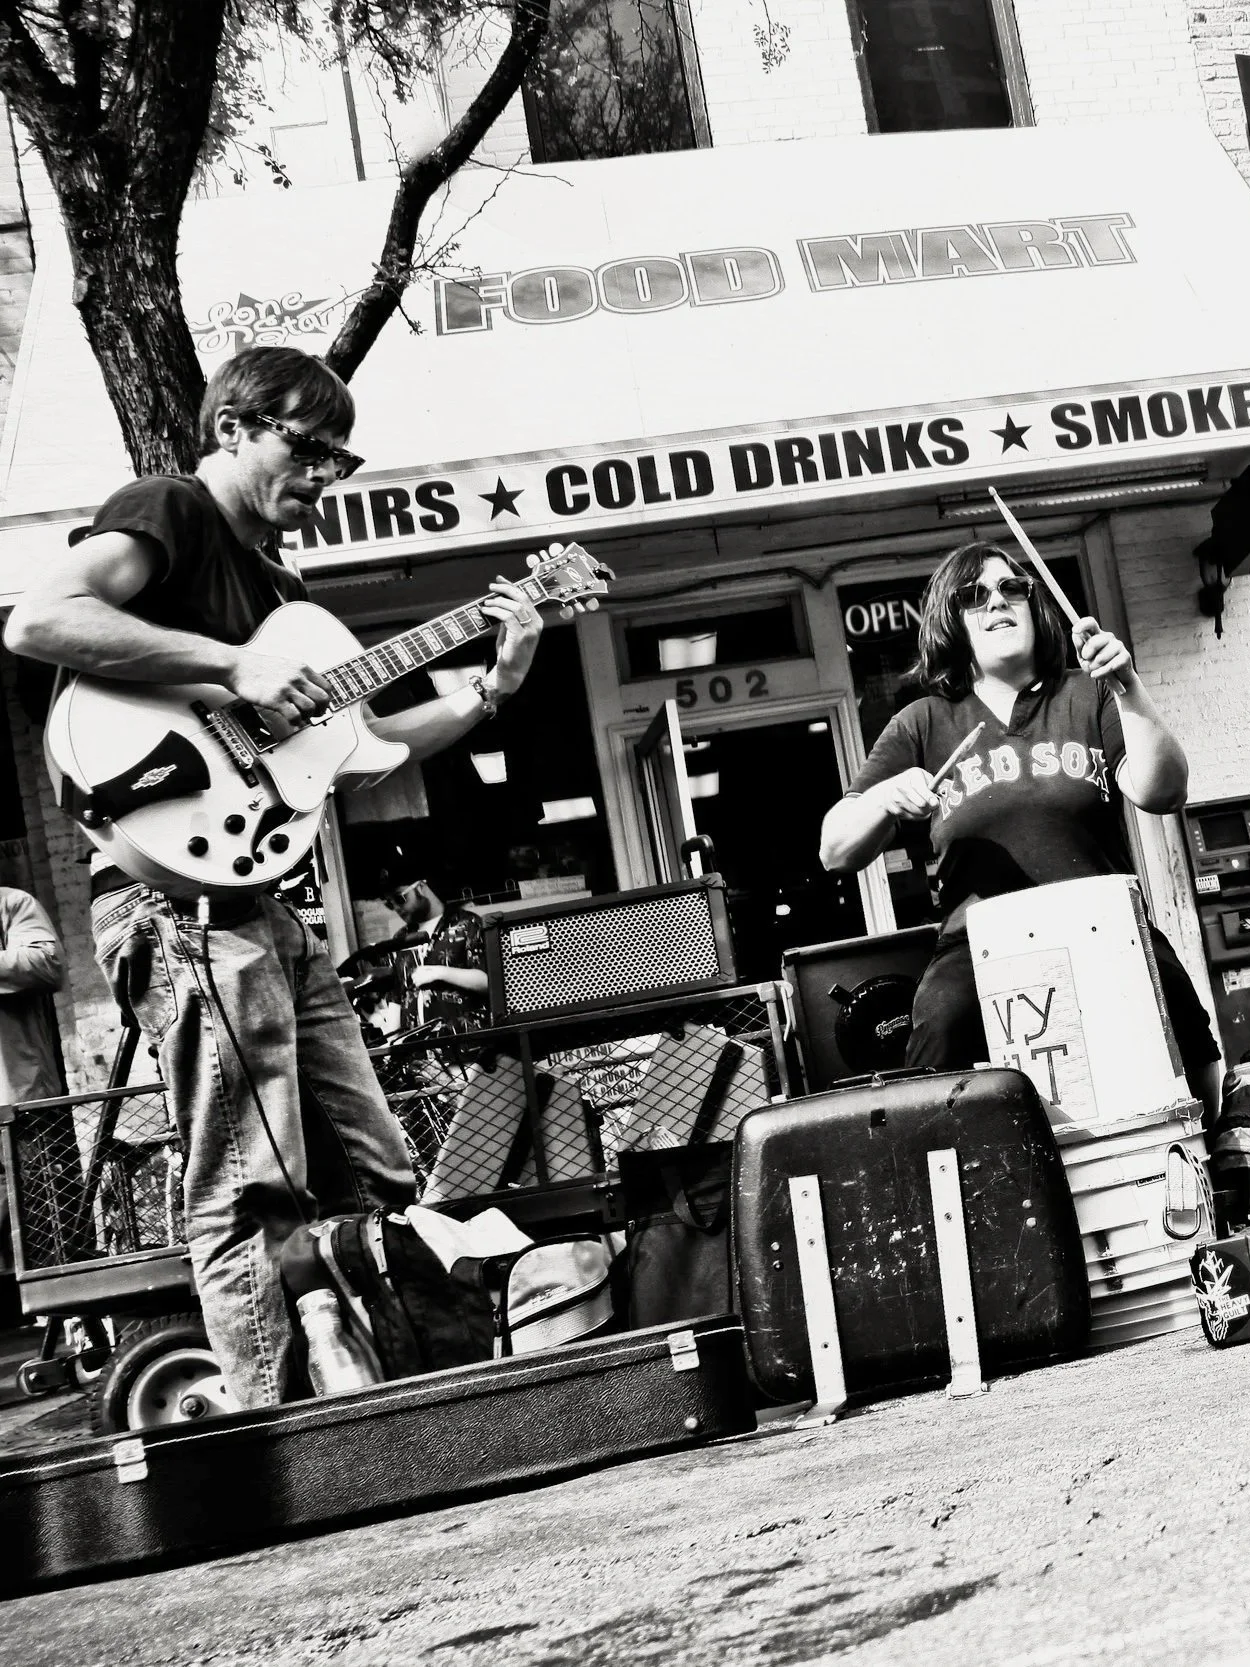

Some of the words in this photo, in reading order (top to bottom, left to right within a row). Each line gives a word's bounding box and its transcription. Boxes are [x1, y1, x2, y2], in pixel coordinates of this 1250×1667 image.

[434, 246, 786, 336] FOOD
[796, 212, 1137, 293] MART
[187, 291, 305, 353] Lone
[252, 309, 335, 348] Star
[283, 480, 461, 551] NIRS
[545, 448, 715, 517] COLD
[728, 416, 970, 493] DRINKS
[845, 599, 924, 636] OPEN
[675, 668, 769, 709] 502
[511, 941, 550, 955] Roland
[1220, 1295, 1249, 1311] HEAVY
[1223, 1305, 1247, 1319] GUILT
